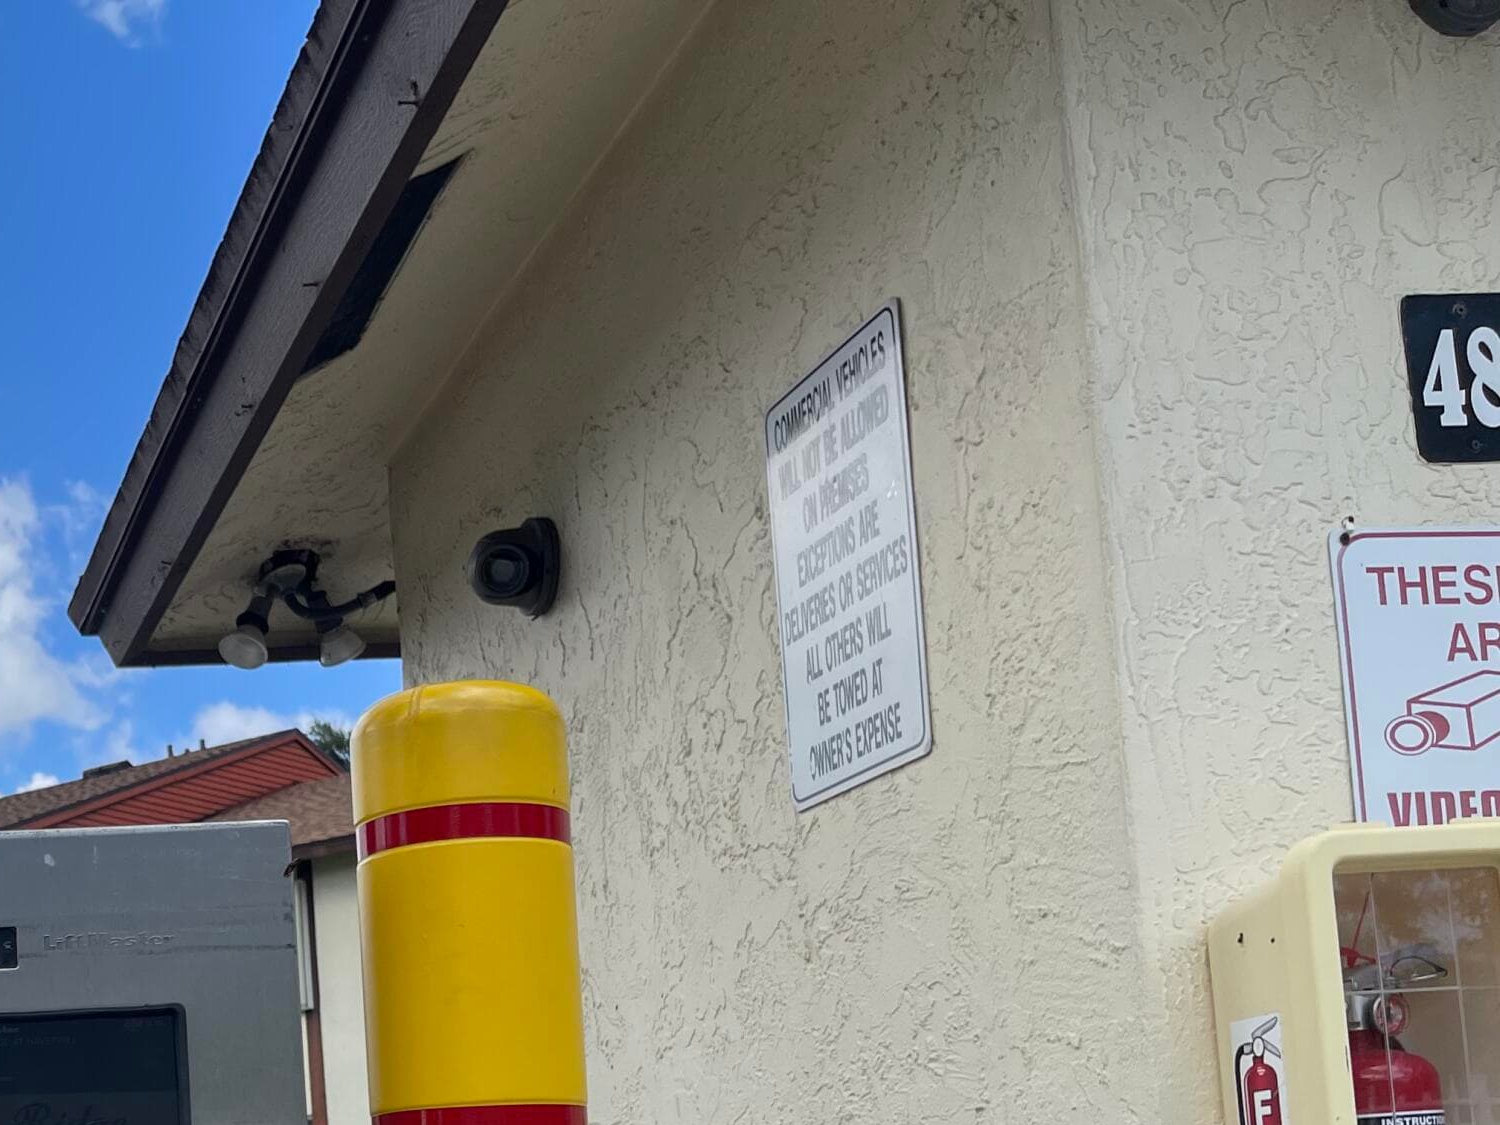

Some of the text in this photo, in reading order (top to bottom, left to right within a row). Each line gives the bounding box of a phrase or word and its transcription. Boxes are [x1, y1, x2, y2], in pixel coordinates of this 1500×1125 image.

[774, 333, 886, 452] COMMERCIAL VEHICLES
[778, 384, 889, 500] WILL NOT BE ALLOWED
[802, 453, 870, 533] ON PREMISES
[796, 501, 881, 588] EXCEPTIONS ARE
[1365, 564, 1500, 605] THES
[785, 534, 908, 646] DELIVERIES OR SERVICES
[806, 602, 891, 683] ALL OTHERS WILL
[817, 657, 884, 726] BE TOWED AT
[809, 702, 902, 781] OWNER'S EXPENSE
